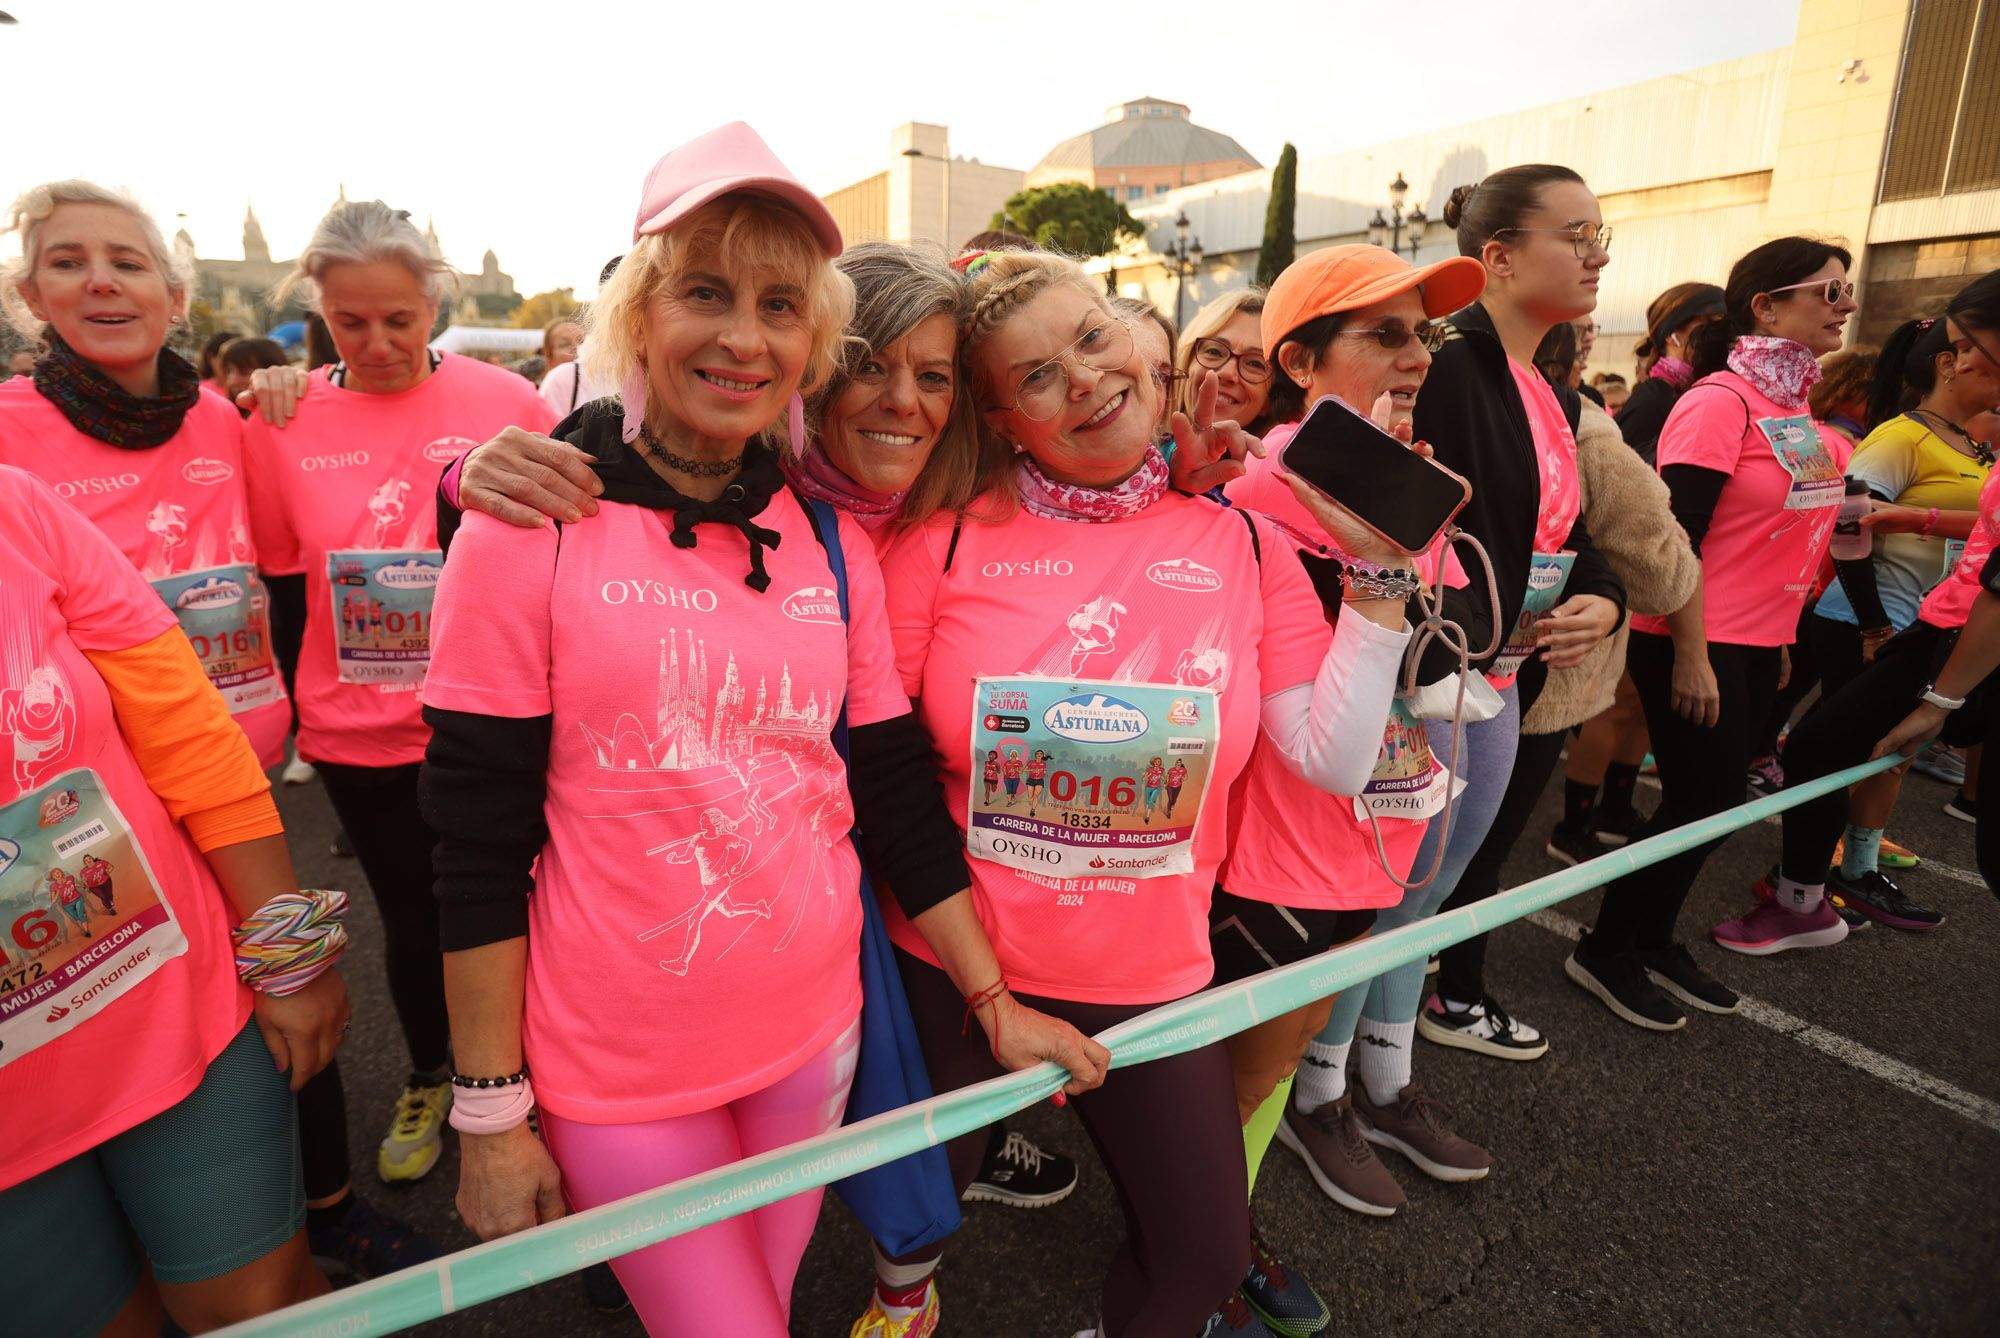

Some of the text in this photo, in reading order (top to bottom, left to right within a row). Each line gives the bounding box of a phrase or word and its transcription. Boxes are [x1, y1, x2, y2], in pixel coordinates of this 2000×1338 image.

[301, 450, 369, 471] OYSHO
[54, 472, 140, 498] OYSHO
[982, 559, 1073, 577] OYSHO
[1153, 568, 1218, 587] ASTURIANA
[601, 580, 719, 613] OYSHO
[791, 601, 840, 617] ASTURI
[386, 611, 431, 633] 01
[990, 699, 1028, 711] SUMA
[1001, 691, 1030, 699] DORSAL
[1051, 709, 1141, 733] ASTURIANA
[1049, 770, 1136, 807] 016
[1375, 781, 1411, 791] CARRERA
[1372, 797, 1424, 810] OYSHO
[993, 816, 1177, 844] CARRERA DE LA MUJER BARCELONA
[1061, 811, 1111, 829] 18334
[993, 838, 1062, 865] OYSHO
[1107, 854, 1169, 869] Santander
[1065, 879, 1080, 892] DE
[1082, 879, 1094, 892] LA
[1096, 879, 1137, 896] MUJER
[1056, 894, 1085, 907] 2024
[1, 978, 58, 1015] MUJER
[64, 921, 143, 978] BARCELONA
[70, 946, 153, 1011] Santander
[671, 1170, 794, 1224] COMUNICACIÓN
[654, 1210, 669, 1227] Y
[574, 1216, 654, 1254] EVENTOS
